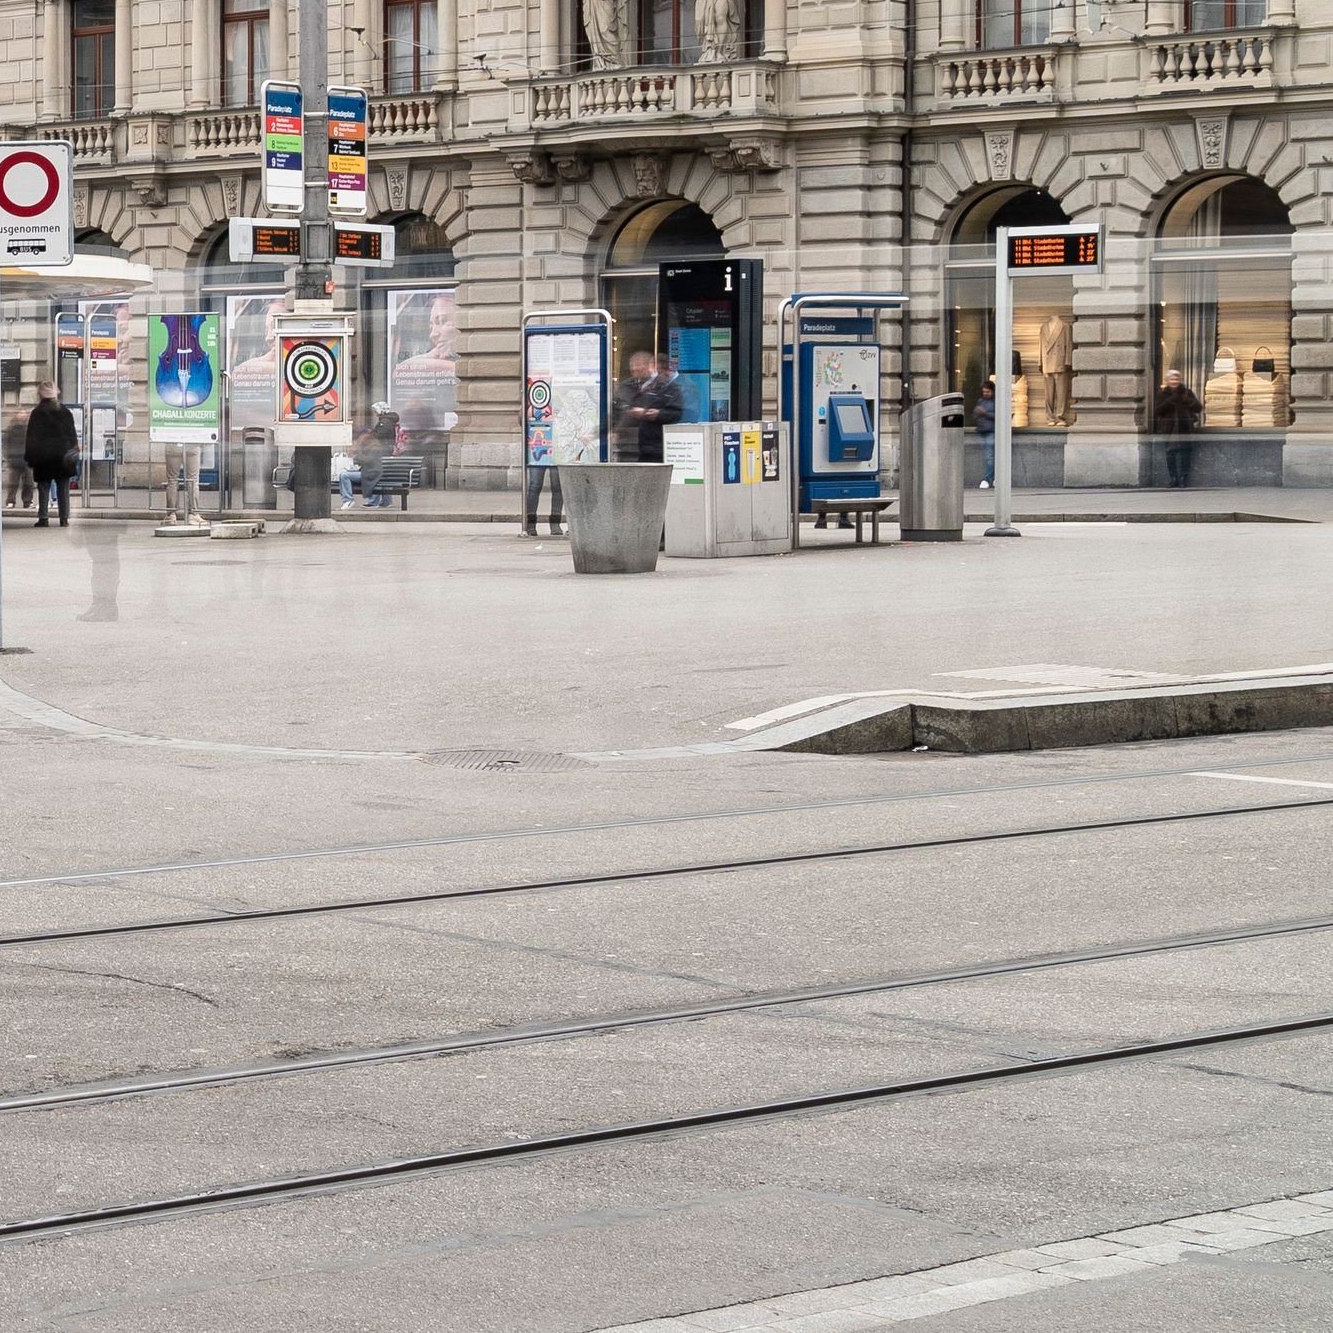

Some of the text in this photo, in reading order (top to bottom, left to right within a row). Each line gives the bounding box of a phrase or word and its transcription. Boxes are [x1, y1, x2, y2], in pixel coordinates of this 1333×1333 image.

[803, 323, 836, 332] Paradeplatz
[152, 409, 216, 419] CHAGALL KONZERTE
